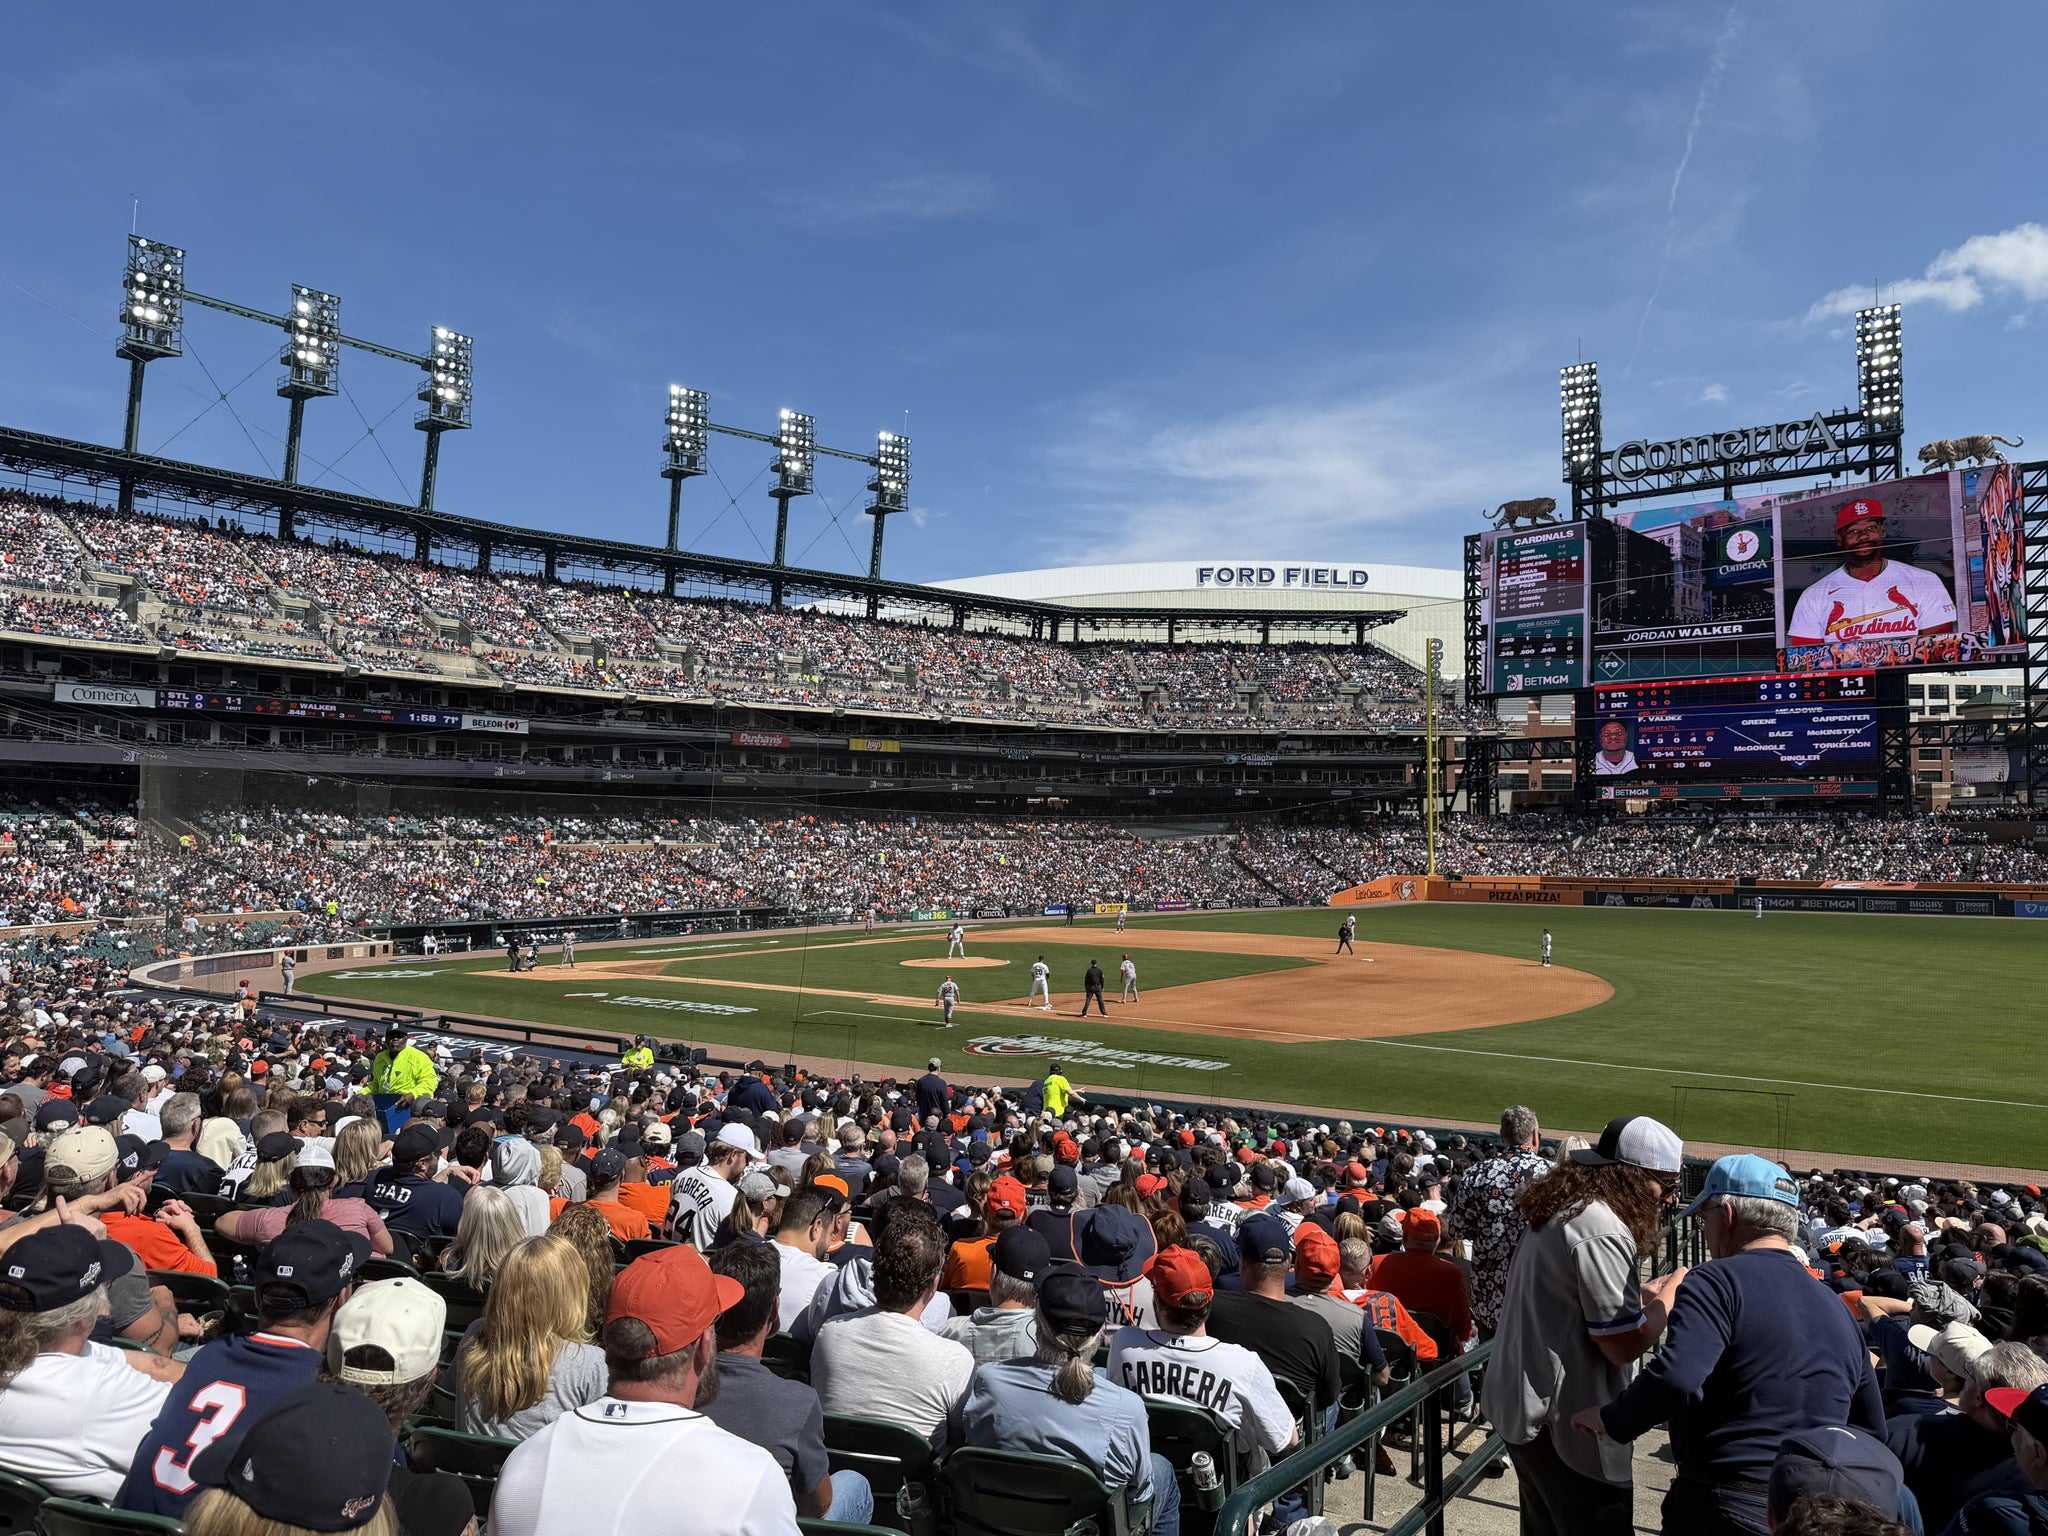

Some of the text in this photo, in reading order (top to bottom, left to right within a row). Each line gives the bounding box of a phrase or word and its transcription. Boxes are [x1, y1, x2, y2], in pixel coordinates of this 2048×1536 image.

[1671, 457, 1798, 486] PARK
[1513, 530, 1574, 546] CARDINALS
[1520, 560, 1551, 568] BURLESON
[1197, 567, 1369, 588] FORD FIELD
[1623, 624, 1743, 642] JORDAN WALKER
[1835, 616, 1918, 643] Cardinals
[1790, 646, 1830, 668] Detroit
[1525, 675, 1569, 686] BETMGM
[1840, 676, 1864, 688] 1-1
[167, 700, 189, 708] DET
[168, 692, 189, 700] STL
[226, 697, 241, 705] 1-1
[300, 702, 337, 712] WALKER
[1775, 706, 1823, 715] MEADOWS
[409, 713, 437, 722] 1:58
[1741, 714, 1870, 726] GREENE CARPENTER
[472, 719, 503, 729] BELFOR
[739, 732, 783, 745] Dunham's
[1768, 728, 1862, 738] BÁEZ McKINSTRY
[1734, 741, 1871, 752] McGONIGLE TORKELSON
[1240, 753, 1279, 764] Gallagher
[1780, 754, 1820, 762] DINGLER
[1489, 890, 1561, 903] PIZZA! PIZZA!
[1810, 899, 1855, 909] BETMGM
[918, 910, 947, 921] bet365
[374, 1182, 412, 1204] DAD
[1121, 1360, 1232, 1413] CABRERA
[152, 1380, 246, 1495] 3
